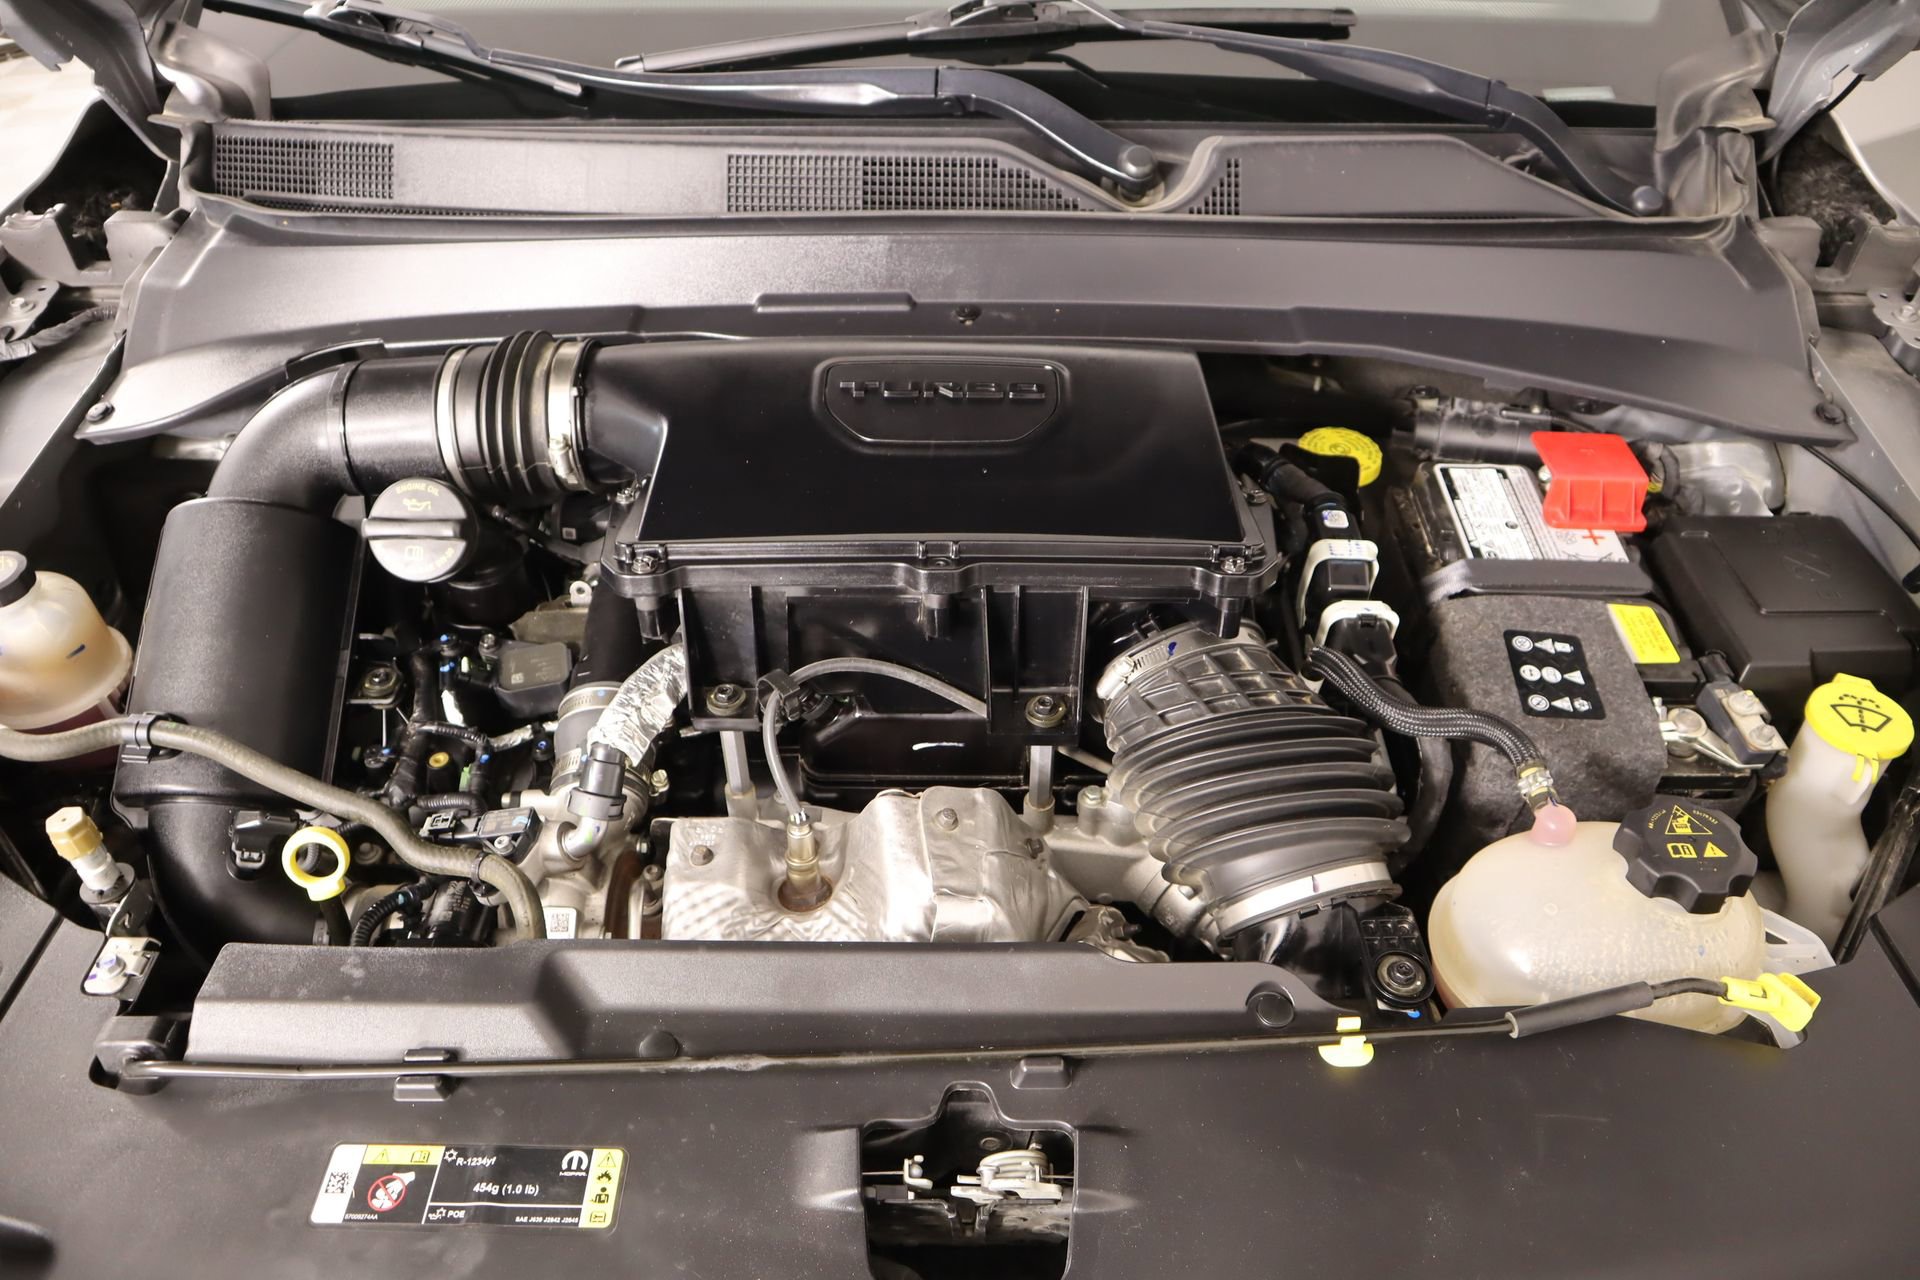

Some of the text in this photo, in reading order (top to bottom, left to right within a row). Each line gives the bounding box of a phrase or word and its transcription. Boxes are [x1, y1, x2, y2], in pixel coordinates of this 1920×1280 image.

[395, 482, 439, 496] ENGINE OIL
[455, 1156, 497, 1167] R-1234yf
[473, 1182, 540, 1196] 454g (1.0 lb)
[447, 1210, 465, 1219] POE
